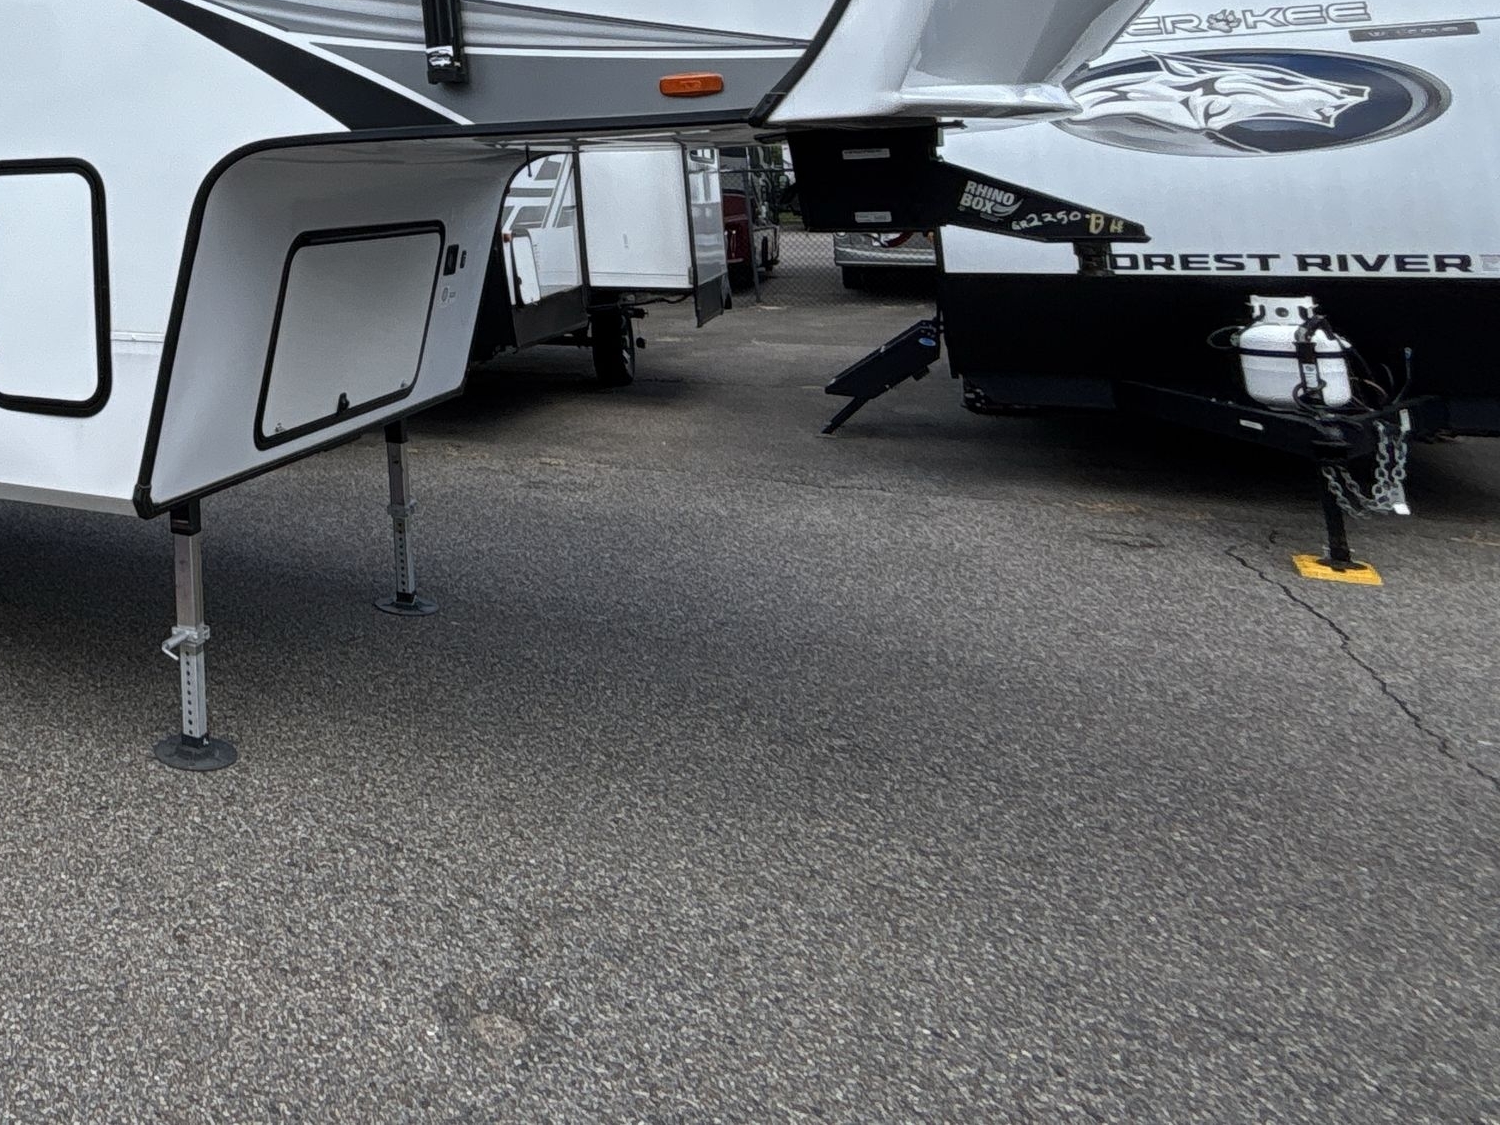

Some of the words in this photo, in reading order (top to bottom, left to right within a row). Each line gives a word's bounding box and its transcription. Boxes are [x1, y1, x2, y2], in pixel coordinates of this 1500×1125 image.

[960, 192, 995, 214] BOX
[964, 180, 1015, 206] RHINO
[1108, 253, 1281, 273] OREST
[1294, 253, 1474, 273] RIVER
